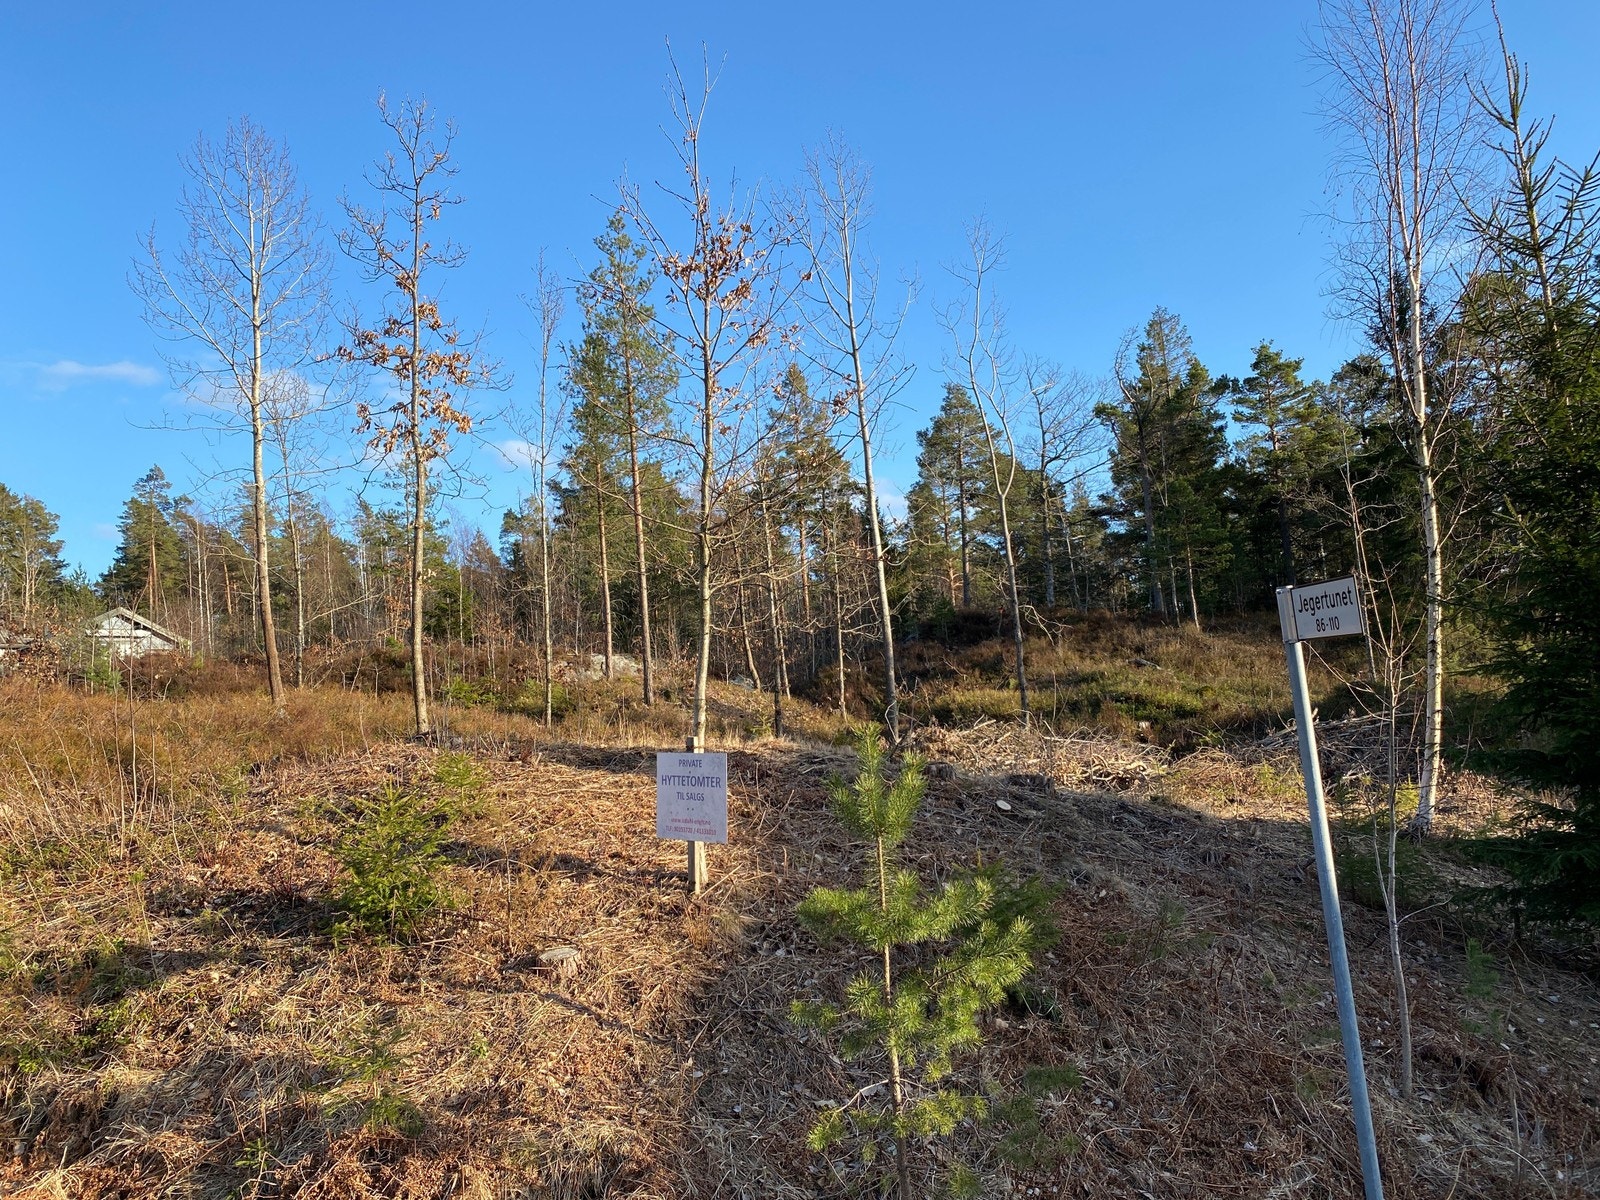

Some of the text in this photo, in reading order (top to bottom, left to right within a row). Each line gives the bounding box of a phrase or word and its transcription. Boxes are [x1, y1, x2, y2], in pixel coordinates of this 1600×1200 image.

[1298, 586, 1353, 616] Jegertunet
[1315, 616, 1340, 632] 86-110
[678, 759, 702, 768] PRIVATE
[661, 774, 721, 788] HYTTETOMTER
[676, 791, 705, 802] TIL SALGS
